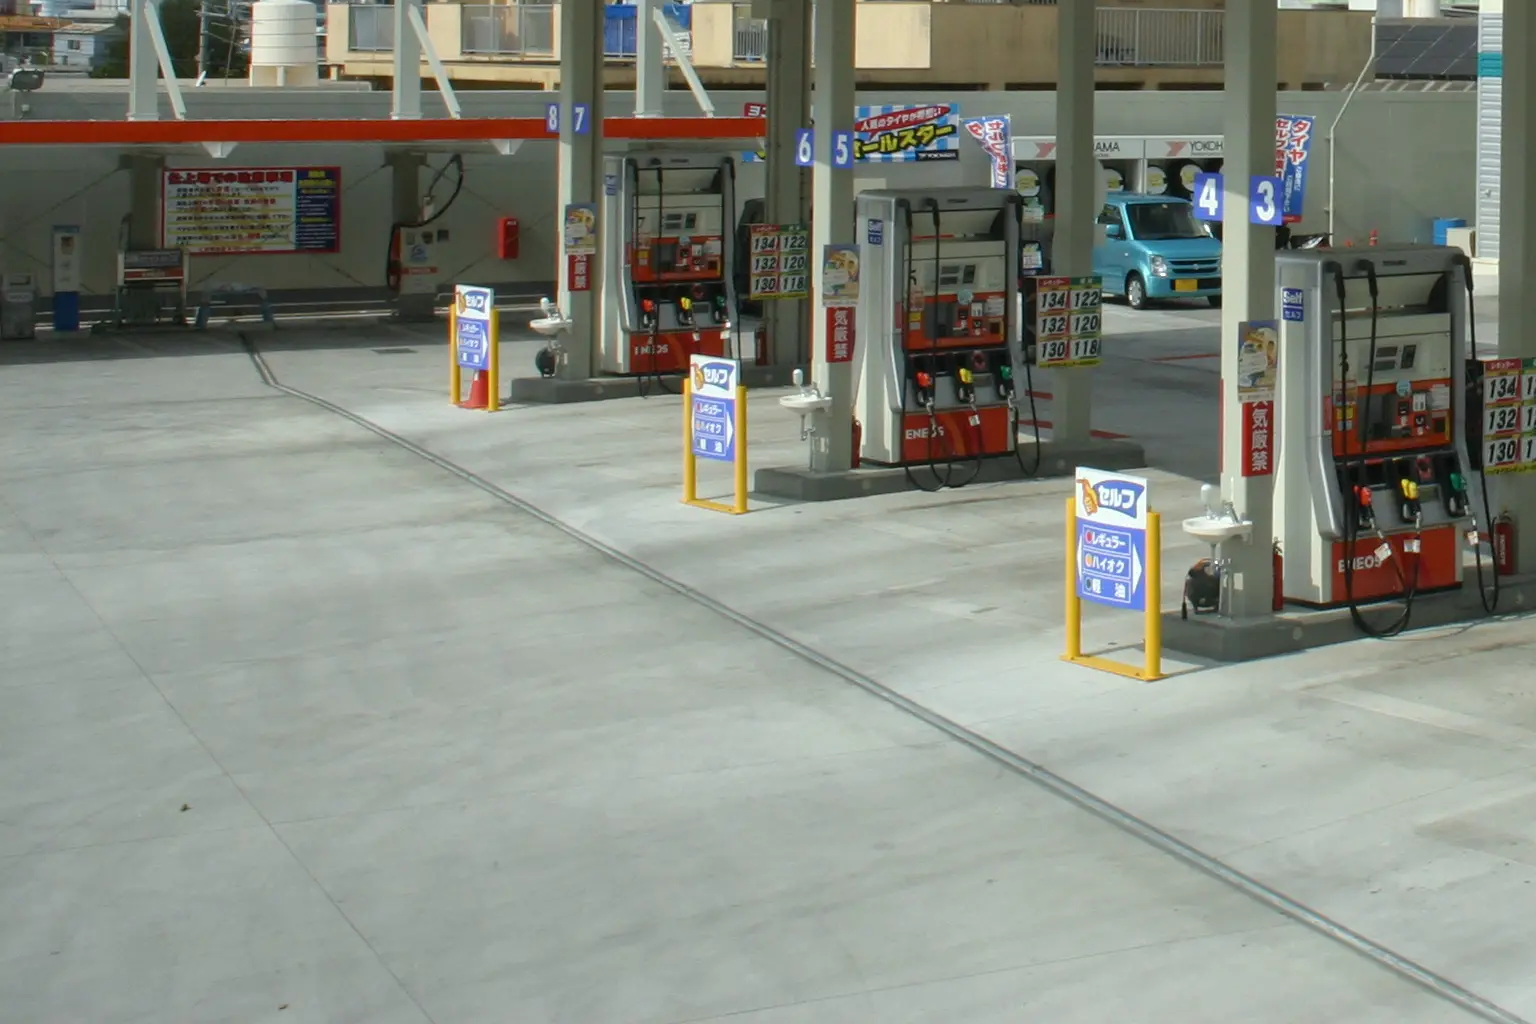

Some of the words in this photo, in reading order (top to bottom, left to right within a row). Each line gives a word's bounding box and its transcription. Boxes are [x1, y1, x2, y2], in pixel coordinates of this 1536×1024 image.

[548, 106, 558, 132] 8
[575, 107, 584, 131] 7
[799, 133, 811, 163] 6
[836, 134, 848, 164] 5
[1190, 141, 1223, 152] YOKOH
[1288, 120, 1310, 165] タイヤ
[1198, 178, 1218, 216] 4
[1256, 180, 1275, 221] 3
[755, 236, 776, 249] 134
[784, 235, 804, 245] 122
[755, 257, 776, 270] 132
[784, 256, 804, 269] 120
[755, 278, 776, 292] 130
[783, 279, 804, 291] 118
[1042, 293, 1065, 308] 134
[1075, 291, 1098, 306] 122
[1283, 290, 1303, 305] Self
[1042, 317, 1065, 333] 132
[1075, 316, 1098, 331] 120
[1042, 342, 1065, 358] 130
[1075, 340, 1097, 356] 118
[703, 367, 728, 384] セルフ
[1489, 378, 1516, 398] 134
[1489, 409, 1516, 430] 132
[1489, 441, 1516, 463] 130
[1098, 484, 1135, 509] セルフ
[1092, 531, 1126, 549] レギュラー
[1093, 556, 1125, 573] ハイオク
